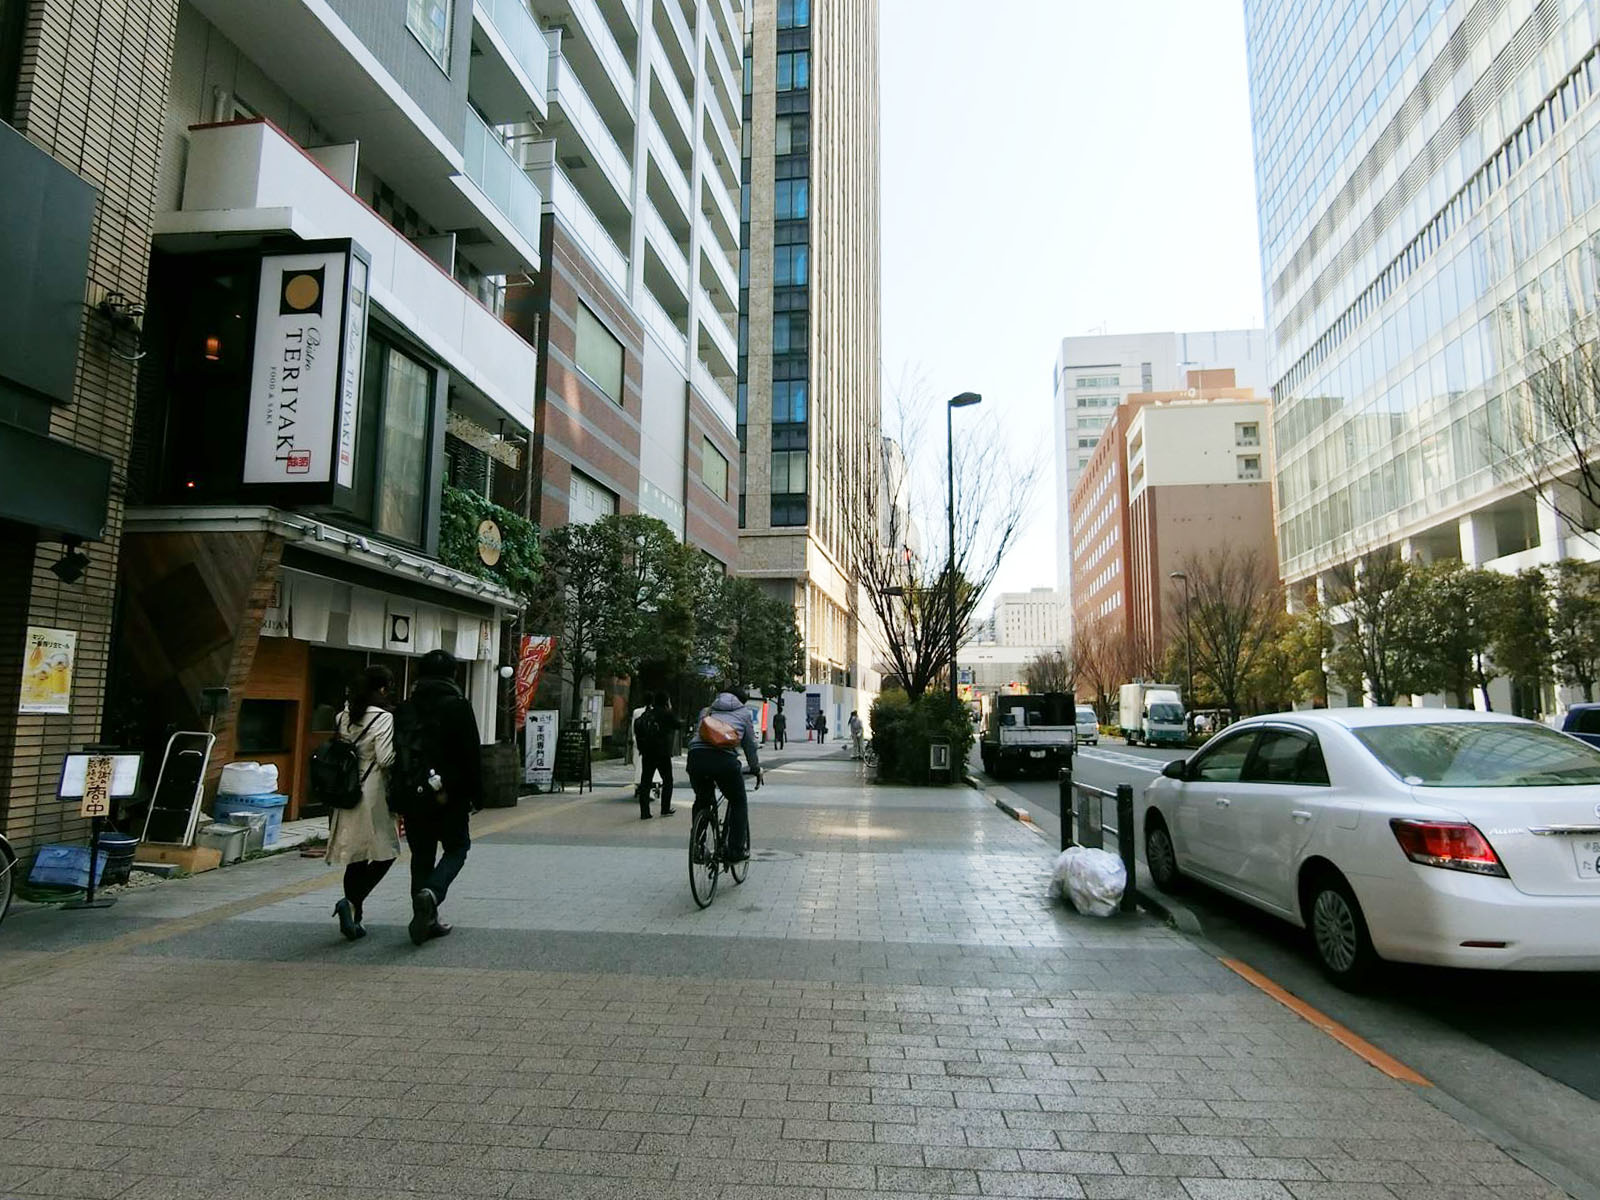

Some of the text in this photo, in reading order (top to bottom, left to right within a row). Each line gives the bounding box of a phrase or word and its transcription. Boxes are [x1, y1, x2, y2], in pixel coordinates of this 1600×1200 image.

[304, 326, 321, 371] Bistro
[269, 366, 277, 391] FOOD
[275, 327, 303, 462] TERIYAKI
[265, 402, 274, 425] SAKE
[341, 368, 355, 447] TERIYAKI
